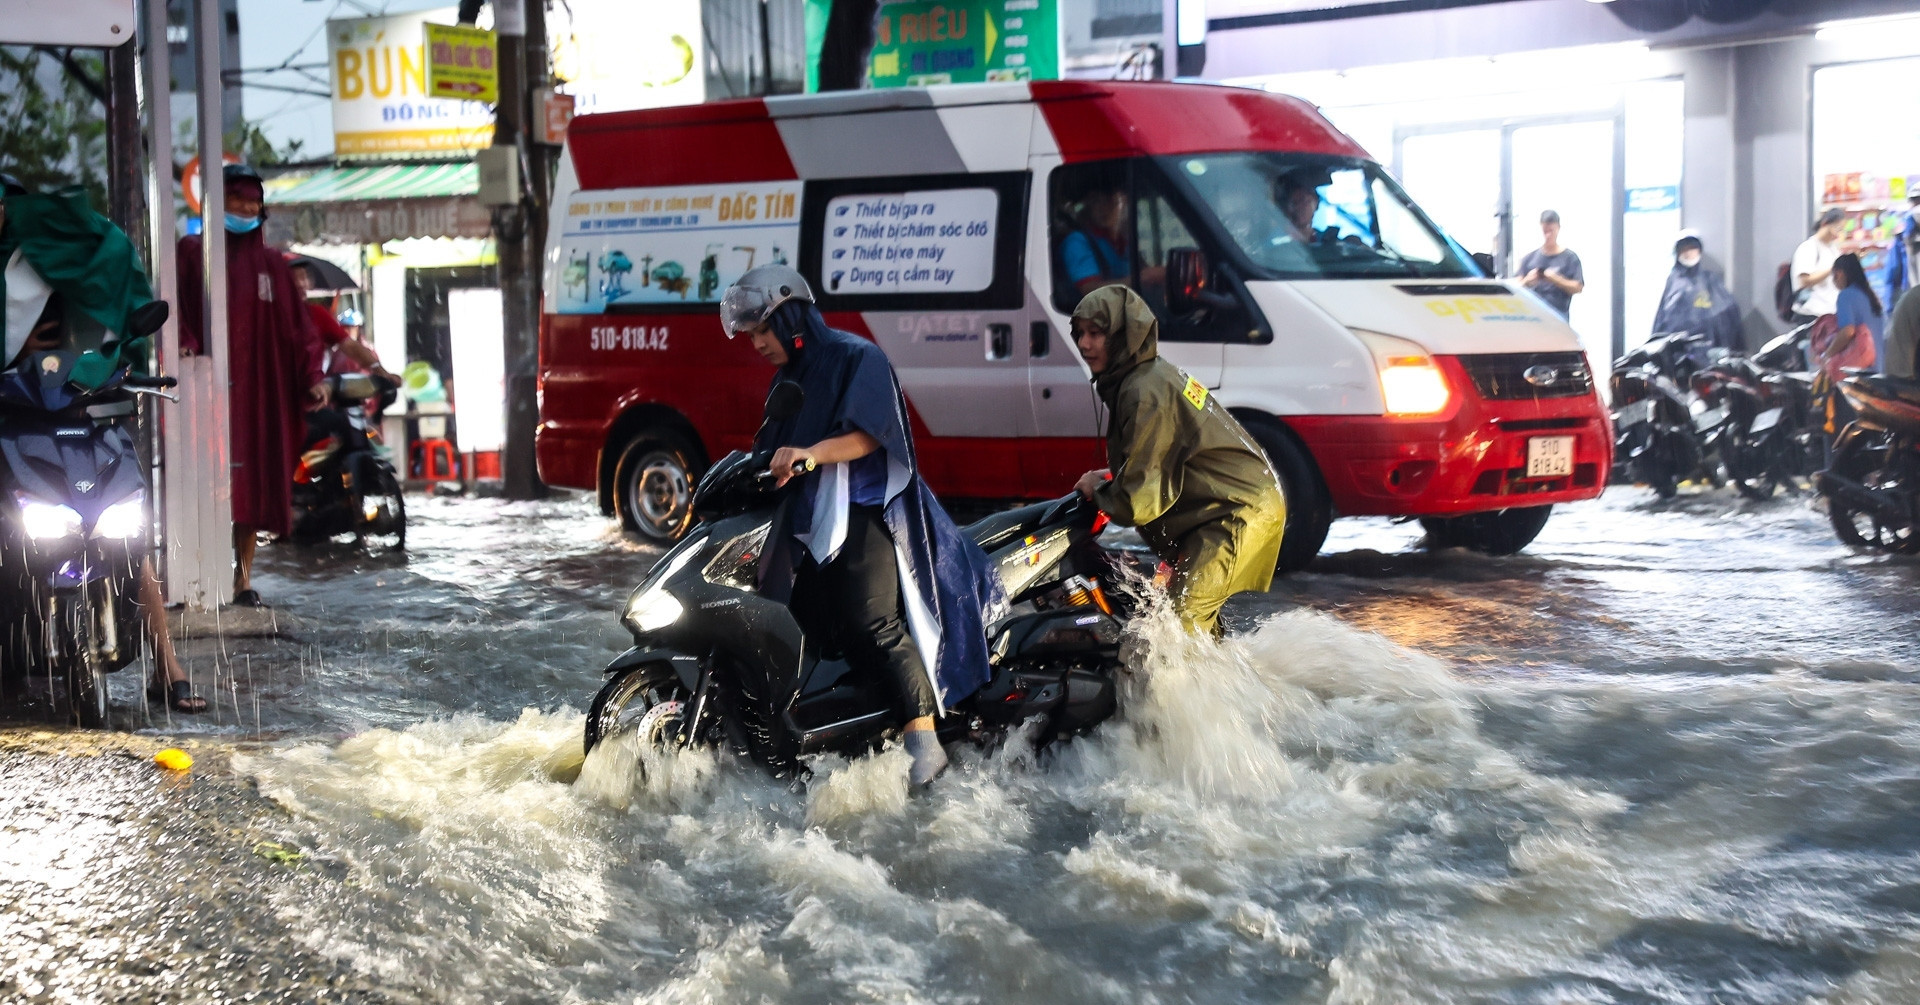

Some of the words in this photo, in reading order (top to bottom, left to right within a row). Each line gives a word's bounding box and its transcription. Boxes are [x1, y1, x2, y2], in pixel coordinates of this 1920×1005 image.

[900, 5, 967, 44] RIÊU
[336, 31, 424, 100] BÚN
[718, 192, 757, 222] ĐẮC
[764, 188, 796, 220] TÍN
[856, 200, 886, 217] Thiết
[903, 203, 918, 220] ga
[921, 202, 935, 216] ra
[854, 221, 884, 239] Thiết
[939, 221, 962, 237] sóc
[852, 243, 882, 260] Thiết
[900, 247, 913, 259] xe
[917, 244, 946, 262] máy
[850, 267, 883, 285] Dụng
[934, 268, 955, 284] tay
[590, 326, 668, 350] 51D-818.42
[899, 314, 980, 342] DATET
[1541, 440, 1559, 455] 51D
[701, 598, 740, 609] HONDA
